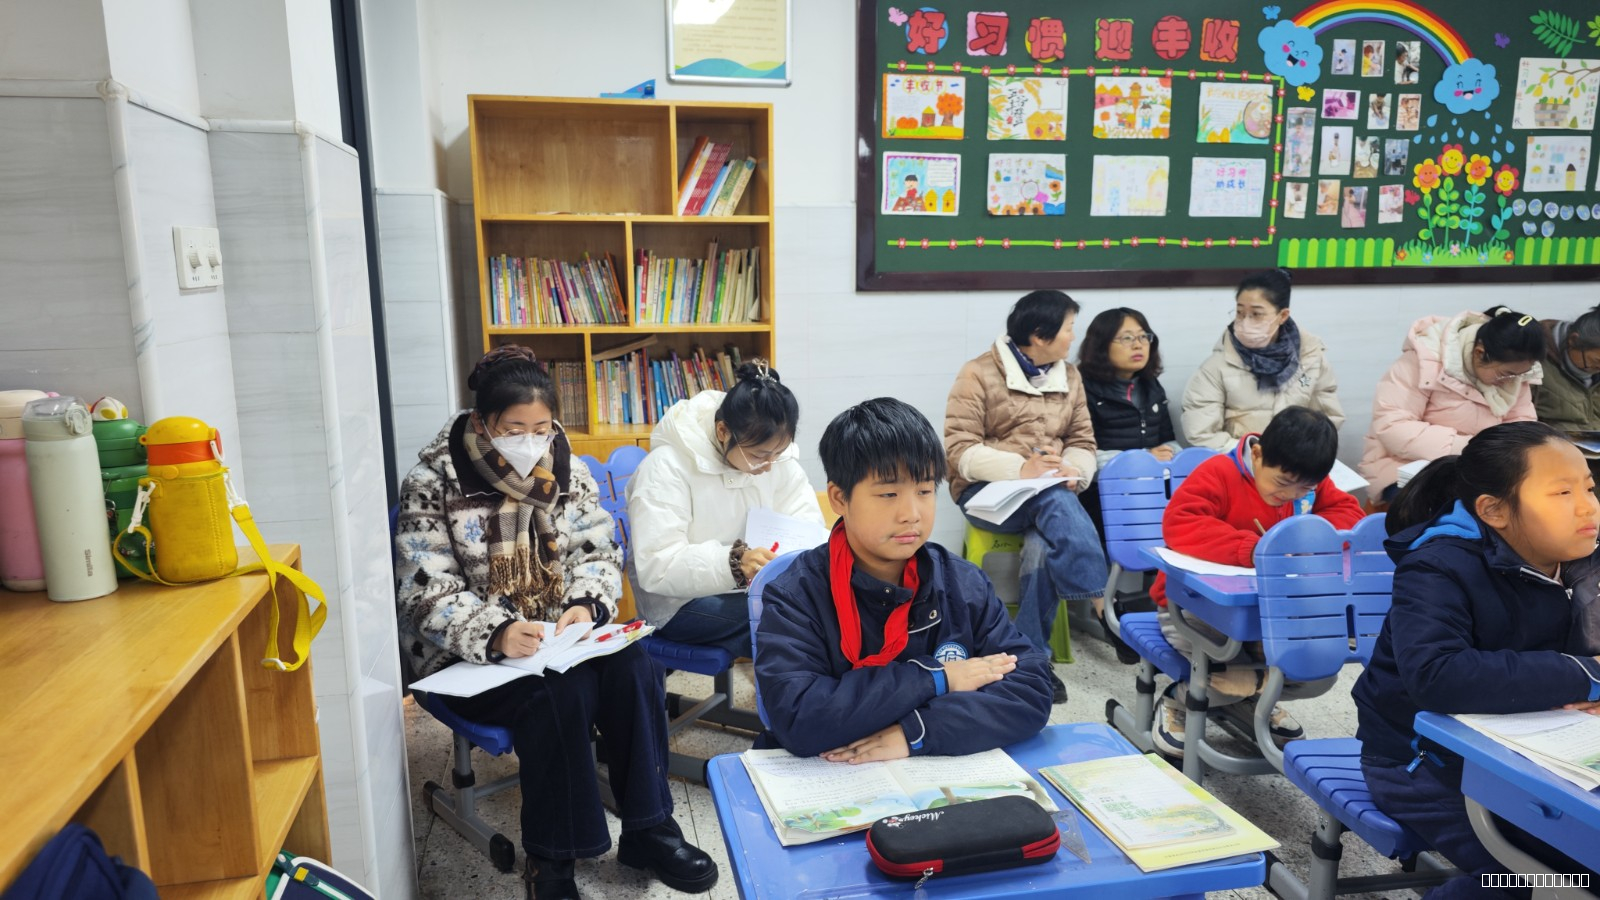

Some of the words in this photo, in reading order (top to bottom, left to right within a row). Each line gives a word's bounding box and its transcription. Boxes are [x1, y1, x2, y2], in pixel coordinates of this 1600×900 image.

[906, 9, 1239, 61] 好习惯迎丰收
[903, 810, 945, 822] Mickey
